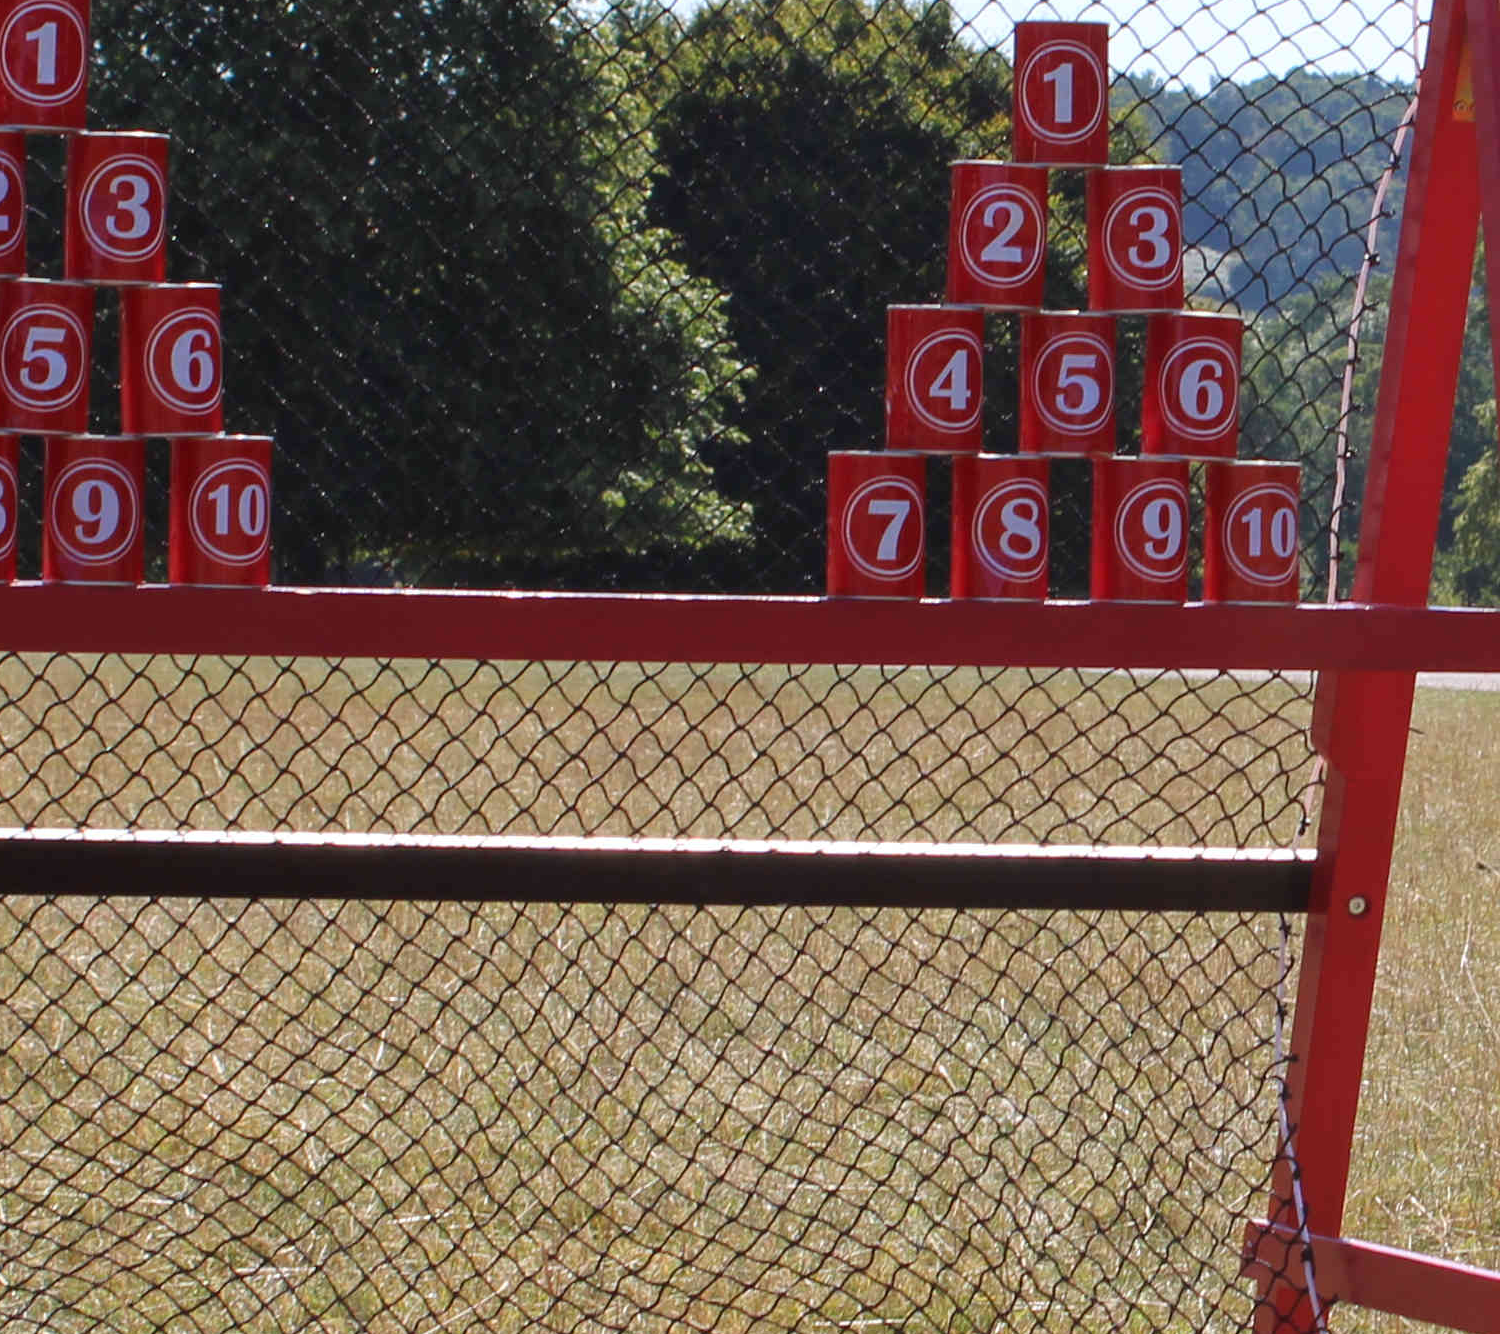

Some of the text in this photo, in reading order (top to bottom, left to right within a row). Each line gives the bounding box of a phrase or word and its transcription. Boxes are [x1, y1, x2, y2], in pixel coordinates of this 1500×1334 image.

[26, 22, 56, 85] 1
[1043, 63, 1072, 123] 1
[105, 175, 150, 239] 3
[980, 202, 1024, 262] 2
[1128, 208, 1170, 268] 3
[20, 327, 68, 390] 5
[171, 328, 213, 392] 6
[928, 349, 971, 410] 4
[1055, 354, 1100, 415] 5
[1179, 358, 1223, 419] 6
[72, 479, 119, 544] 9
[208, 483, 265, 536] 10
[867, 500, 910, 560] 7
[1000, 498, 1040, 560] 8
[1142, 498, 1182, 560] 9
[1240, 507, 1295, 556] 10
